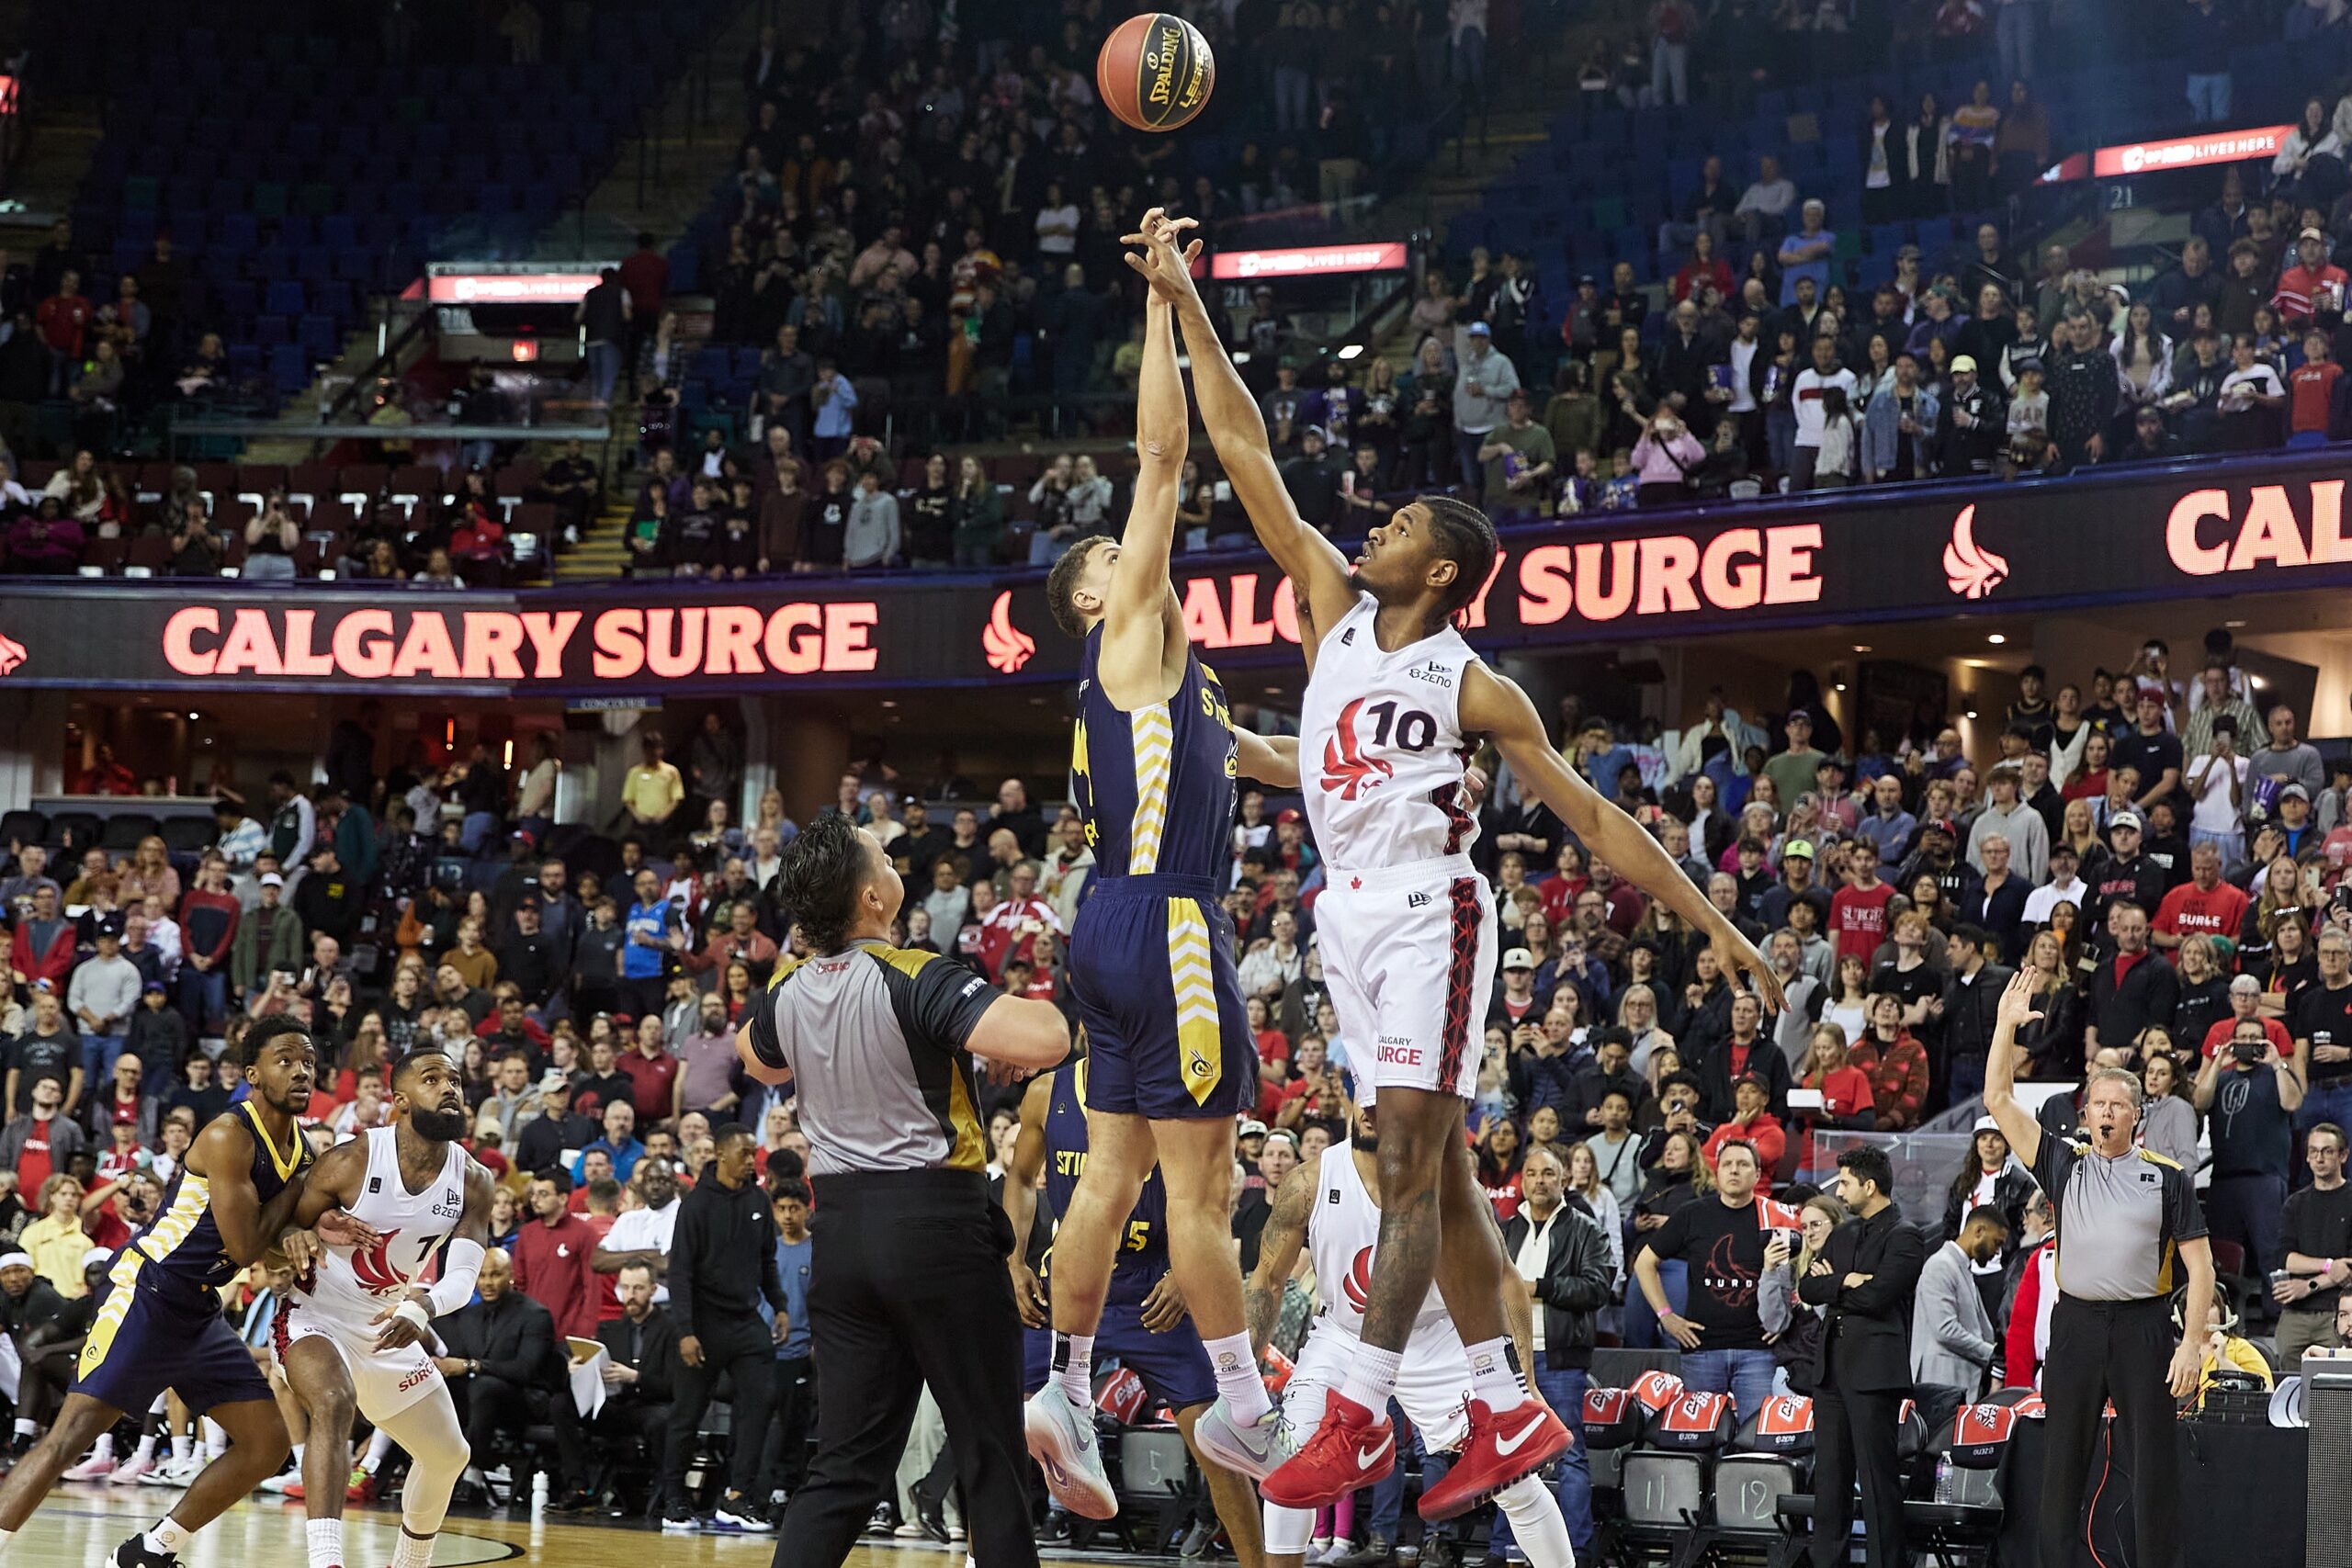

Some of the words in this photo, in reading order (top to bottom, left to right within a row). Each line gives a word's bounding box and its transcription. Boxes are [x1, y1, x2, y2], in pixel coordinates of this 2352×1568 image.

[1149, 27, 1182, 105] SPALDING
[2195, 140, 2235, 158] LIVES
[2237, 136, 2276, 152] HERE
[2166, 479, 2352, 575] CAL
[1519, 524, 1823, 628] SURGE
[164, 606, 582, 679] CALGARY
[593, 602, 877, 679] SURGE
[1366, 700, 1438, 752] 10
[2178, 913, 2222, 928] SURGE
[1377, 1045, 1423, 1066] URGE
[415, 1234, 443, 1263] 7
[1476, 1366, 1497, 1377] CEBL
[1148, 1450, 1162, 1486] 5
[1645, 1473, 1666, 1513] 11
[1740, 1480, 1773, 1522] 12
